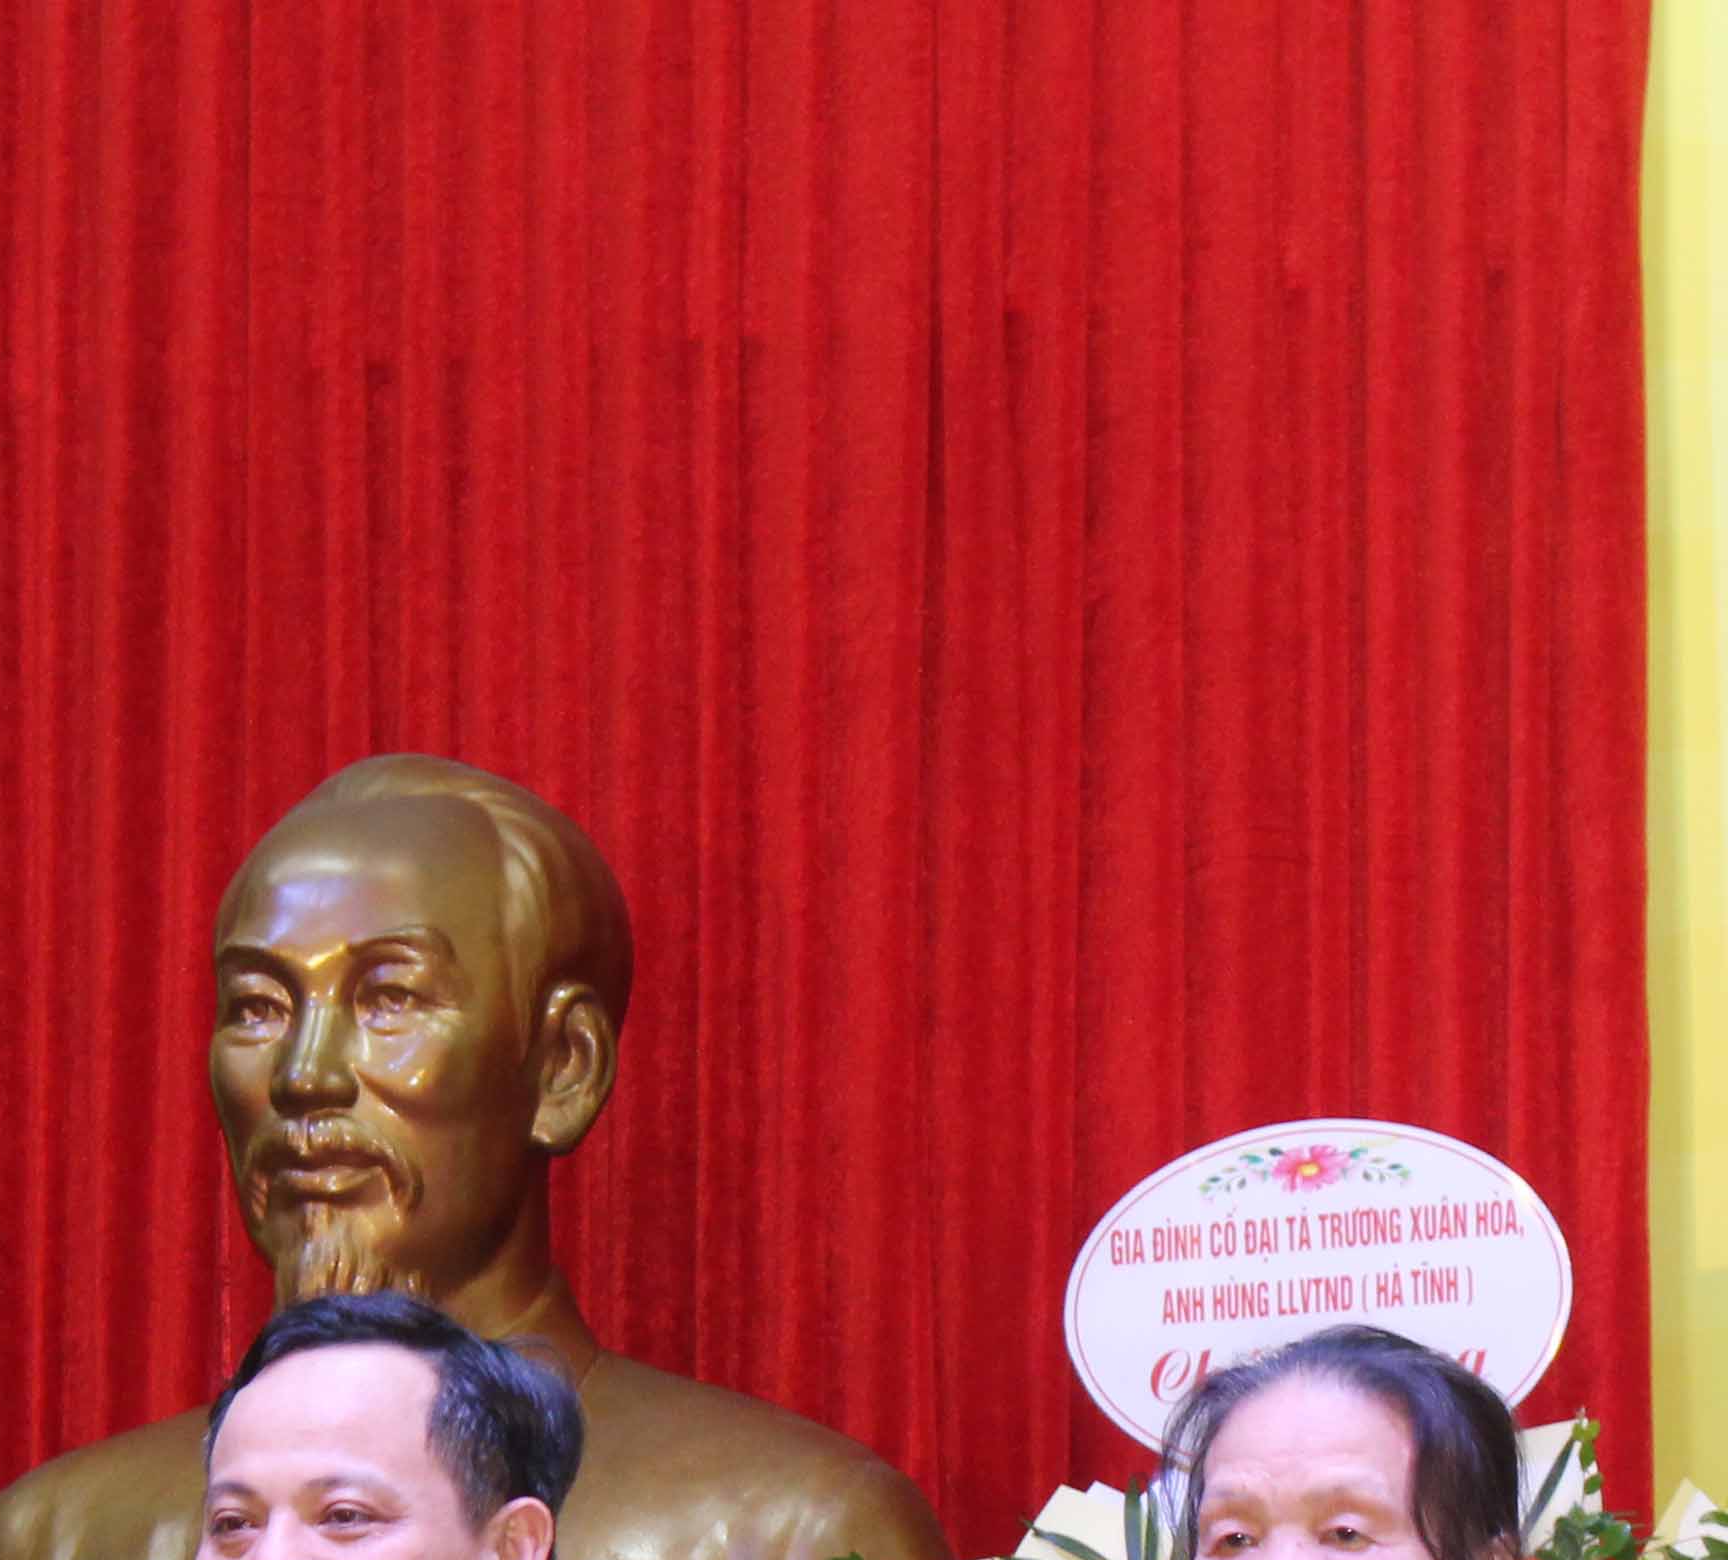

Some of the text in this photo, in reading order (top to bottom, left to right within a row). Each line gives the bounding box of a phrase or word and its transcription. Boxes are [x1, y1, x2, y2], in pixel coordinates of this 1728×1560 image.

[1110, 1228, 1146, 1267] GIA
[1151, 1217, 1202, 1263] ĐÌNH
[1209, 1206, 1238, 1258] CỐ
[1244, 1217, 1280, 1264] ĐẠI
[1318, 1206, 1402, 1249] TRƯƠNG
[1409, 1195, 1468, 1242] XUÂN
[1162, 1286, 1205, 1325] ANH
[1212, 1274, 1270, 1321] HÙNG
[1276, 1274, 1354, 1317] LLVTND
[1375, 1261, 1404, 1309] HÀ
[1410, 1260, 1459, 1306] TĨNH
